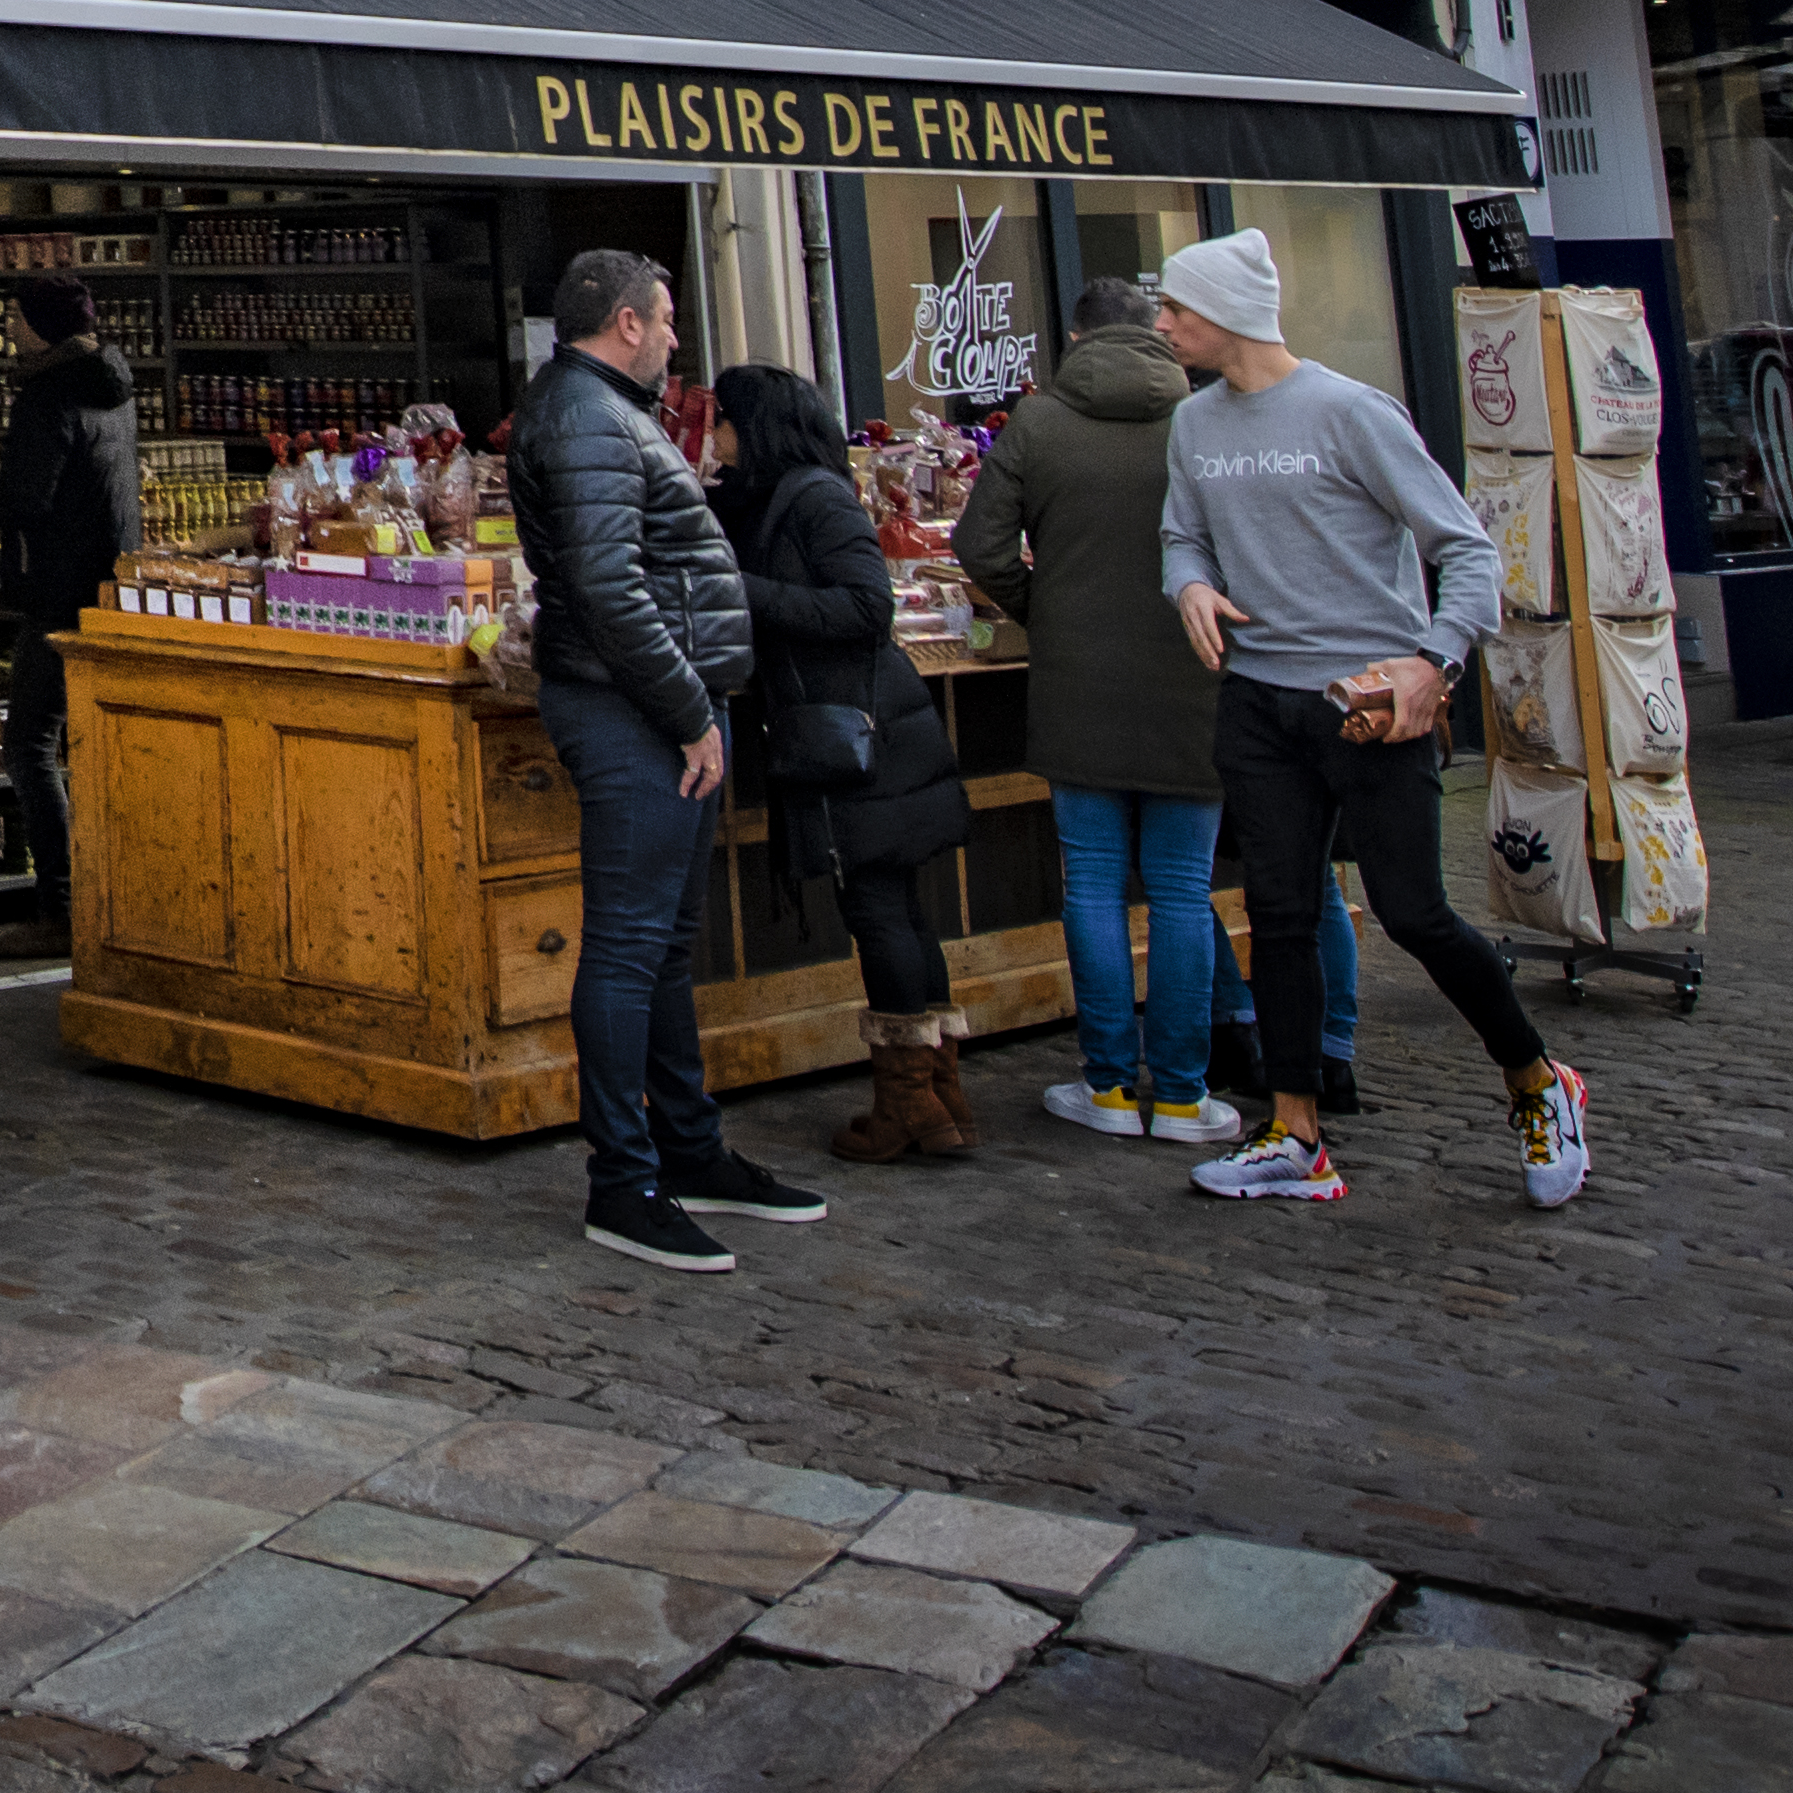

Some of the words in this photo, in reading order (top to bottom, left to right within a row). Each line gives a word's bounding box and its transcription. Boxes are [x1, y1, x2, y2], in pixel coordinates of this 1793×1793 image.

[536, 74, 805, 156] PLAISIRS
[824, 92, 900, 159] DE
[912, 97, 1114, 166] FRANCE
[928, 333, 1038, 399] COUPE
[1193, 451, 1255, 480] Calvin
[1258, 449, 1320, 475] Klein
